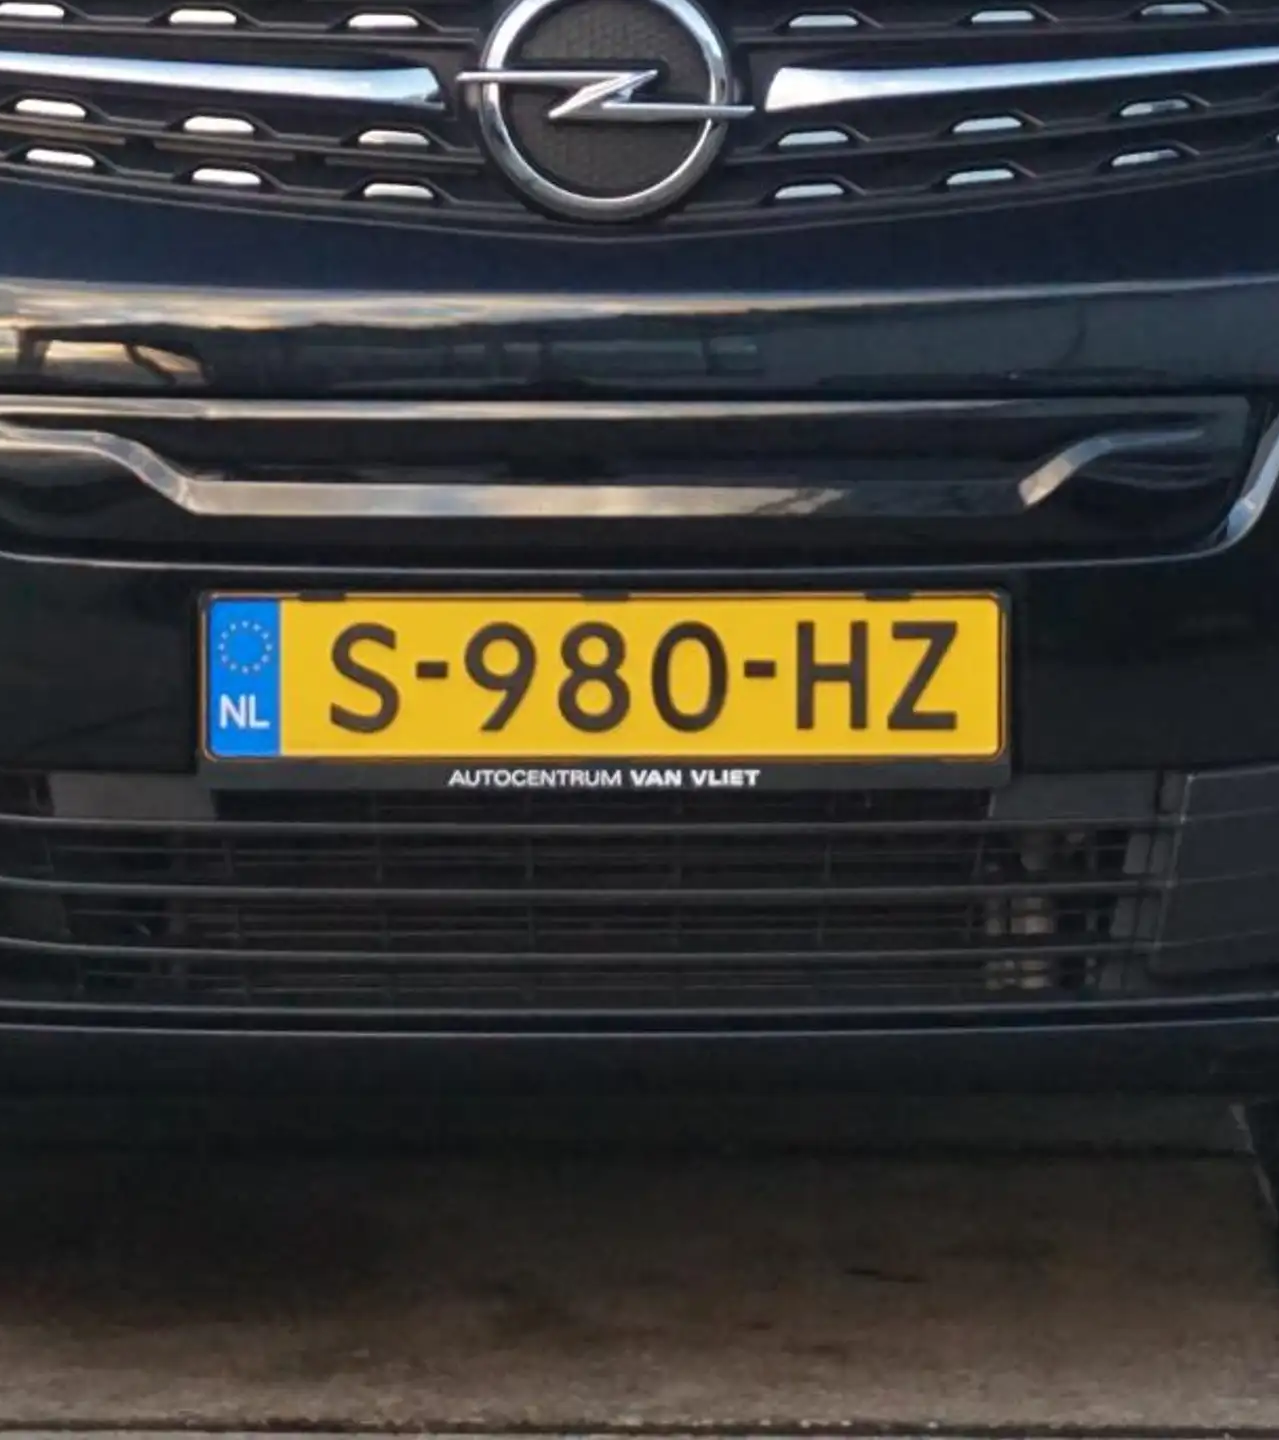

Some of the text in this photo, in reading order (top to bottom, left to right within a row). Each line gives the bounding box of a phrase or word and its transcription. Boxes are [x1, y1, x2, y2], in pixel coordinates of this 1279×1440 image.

[328, 620, 959, 734] S-980-HZ
[219, 693, 271, 730] NL
[447, 768, 761, 788] AUTOCENTRUM VAN VLIET
